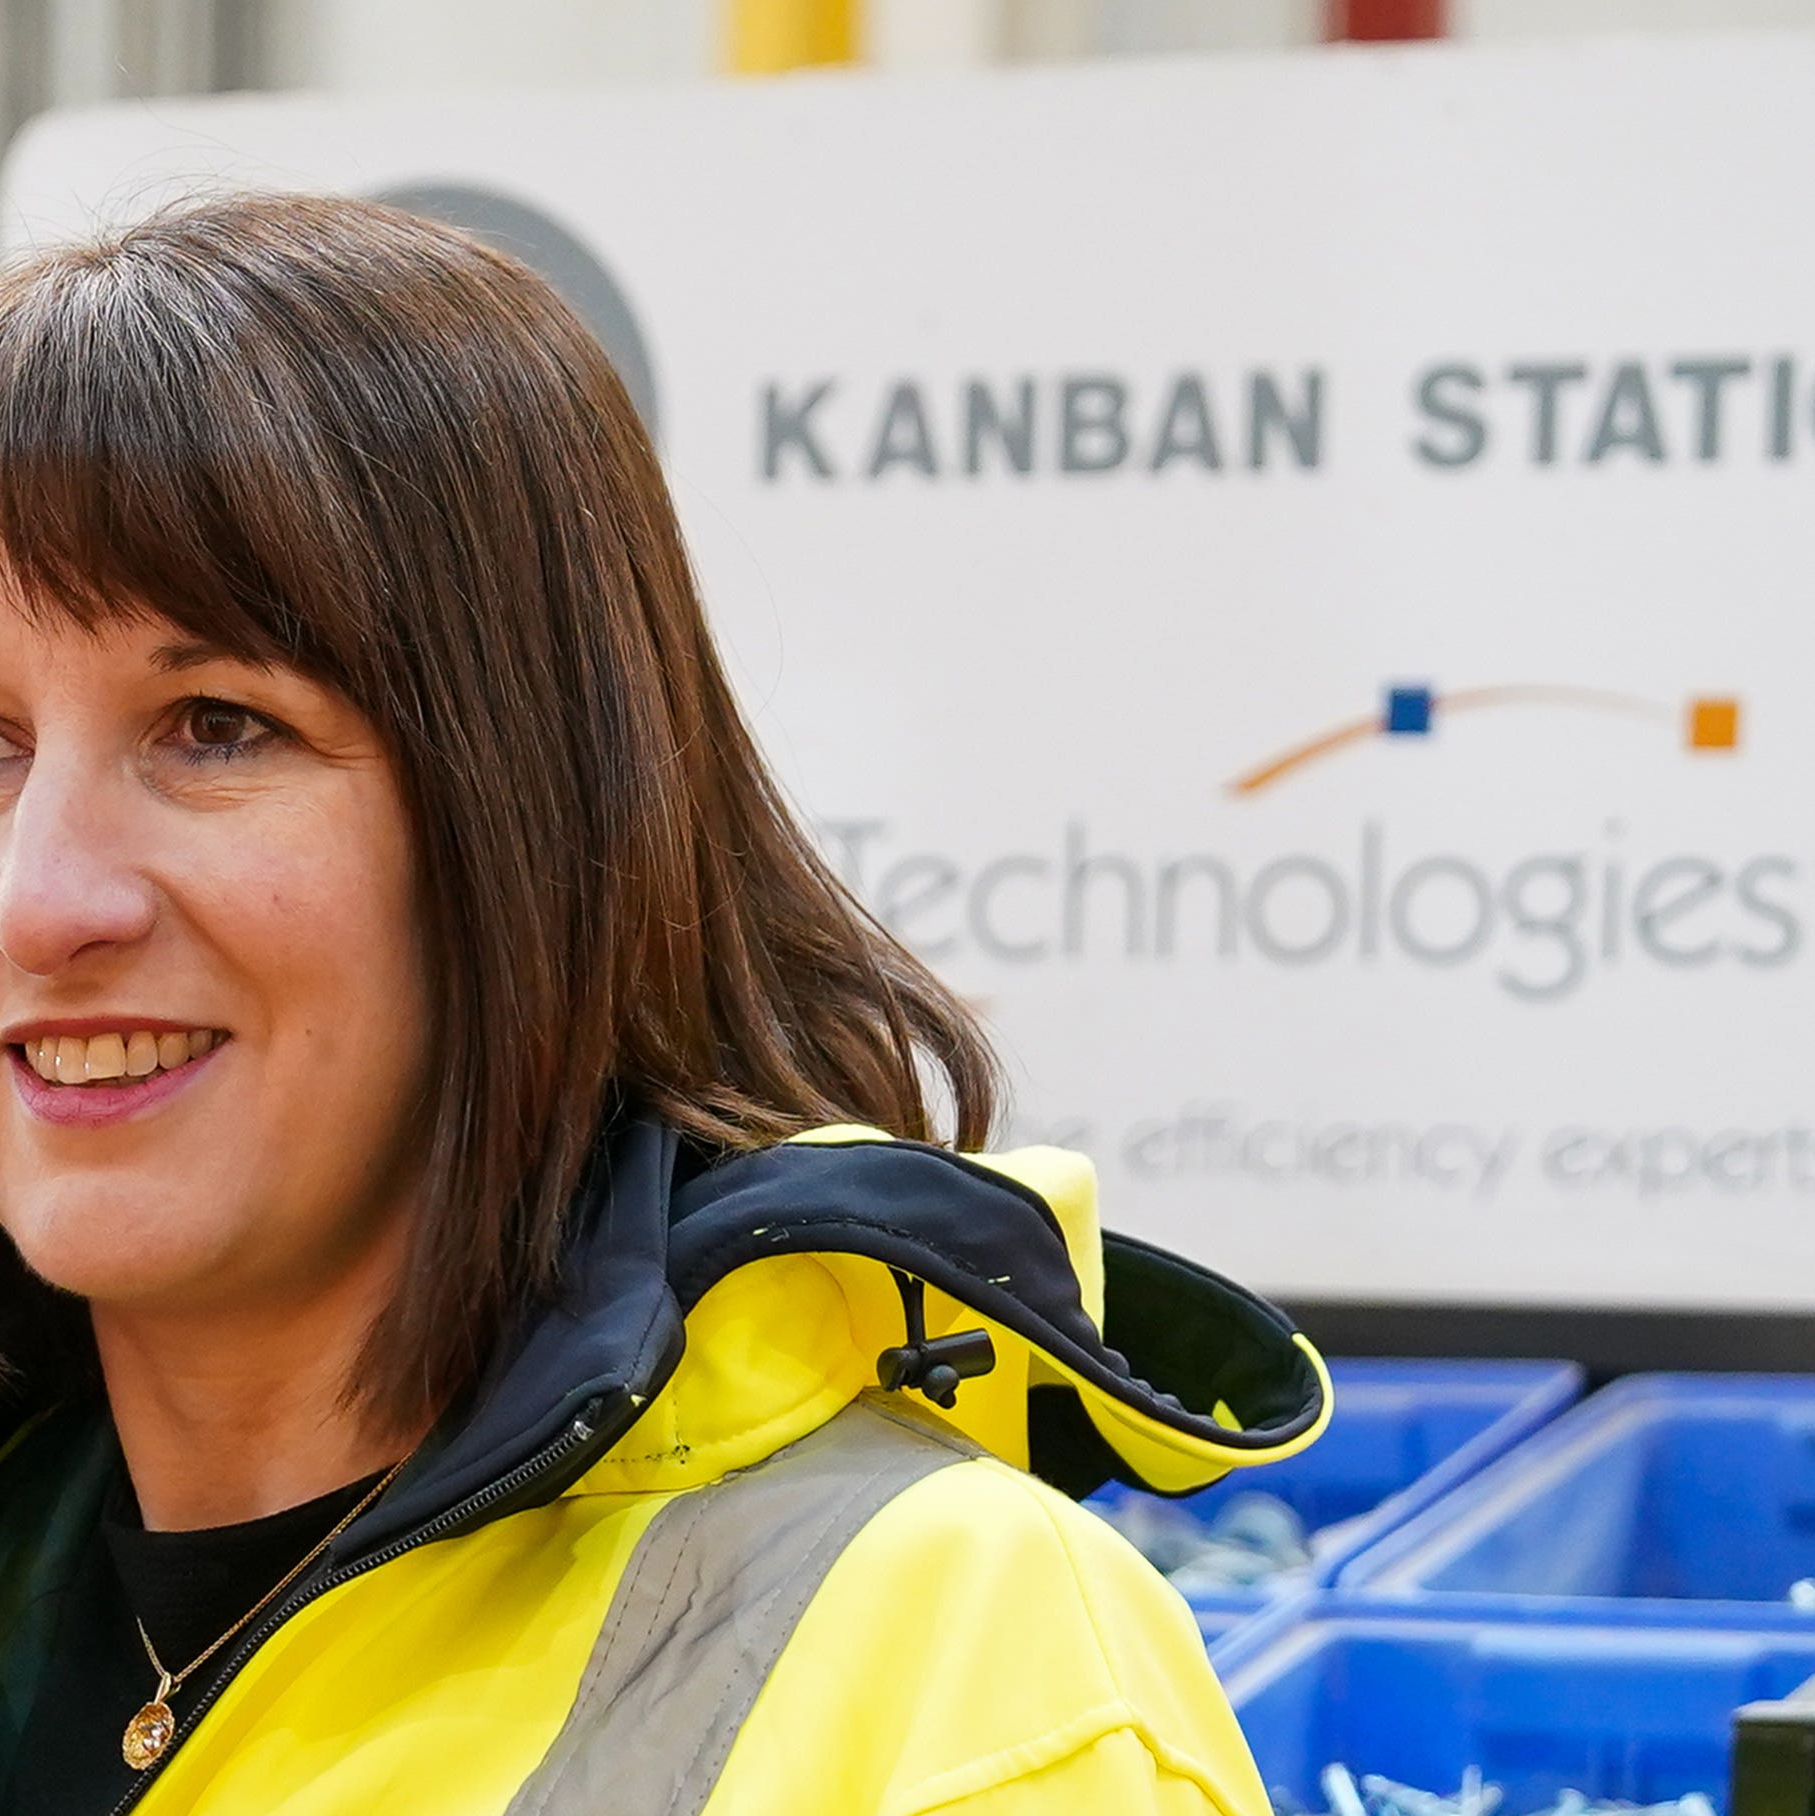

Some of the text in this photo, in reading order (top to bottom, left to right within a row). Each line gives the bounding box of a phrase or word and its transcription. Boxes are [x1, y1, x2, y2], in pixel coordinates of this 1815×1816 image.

[760, 355, 1814, 481] KANBAN STATI
[819, 815, 1803, 1004] Technologies
[1117, 1099, 1521, 1199] efficiency
